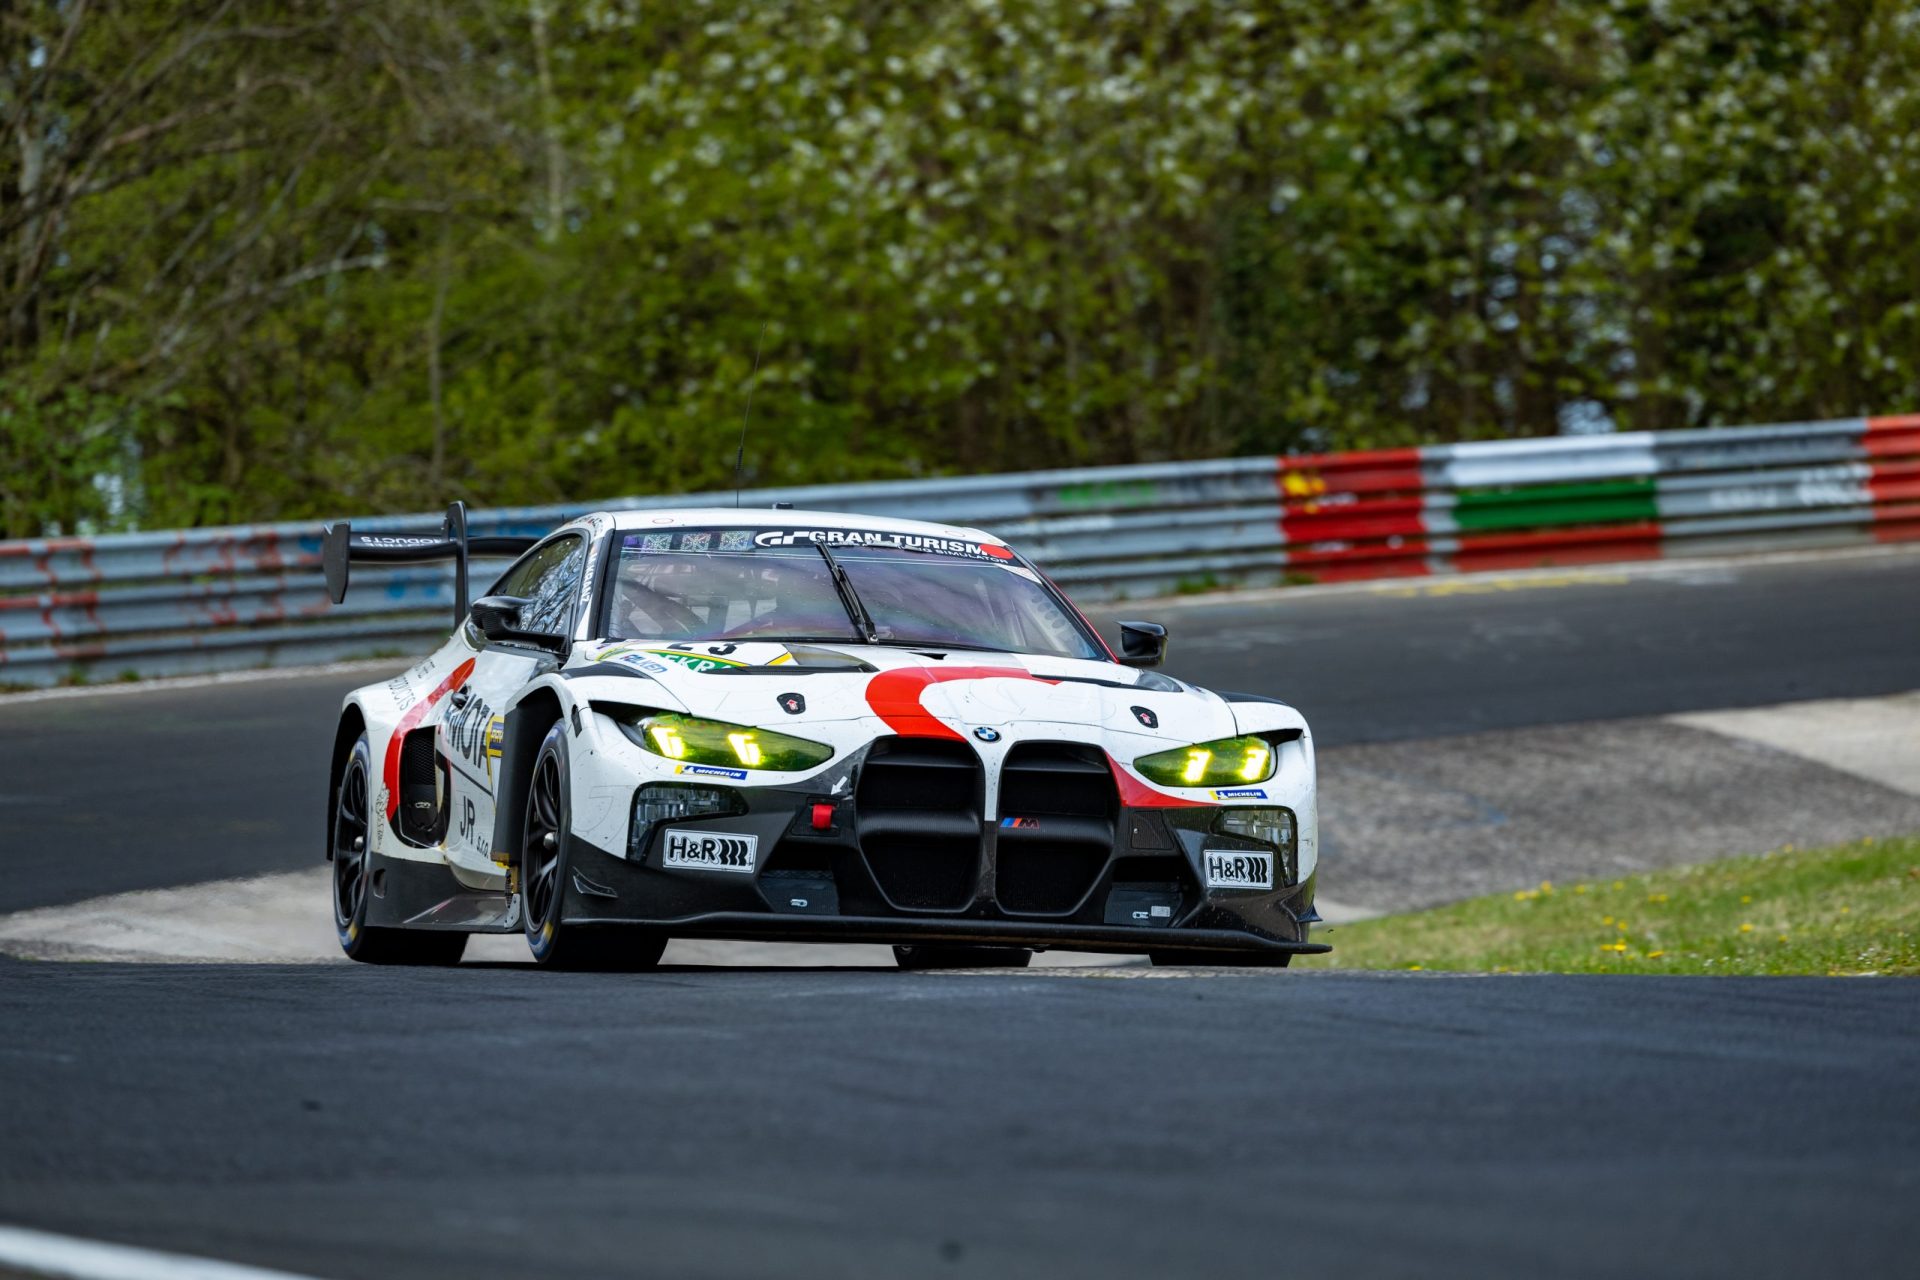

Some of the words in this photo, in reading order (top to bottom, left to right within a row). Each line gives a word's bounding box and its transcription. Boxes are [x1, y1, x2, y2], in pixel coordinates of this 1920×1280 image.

[809, 531, 881, 543] GRAN
[889, 535, 989, 556] TURISM
[696, 768, 742, 777] MICHELIN
[460, 795, 475, 845] JR
[669, 837, 717, 861] H&R
[1208, 857, 1247, 879] H&R
